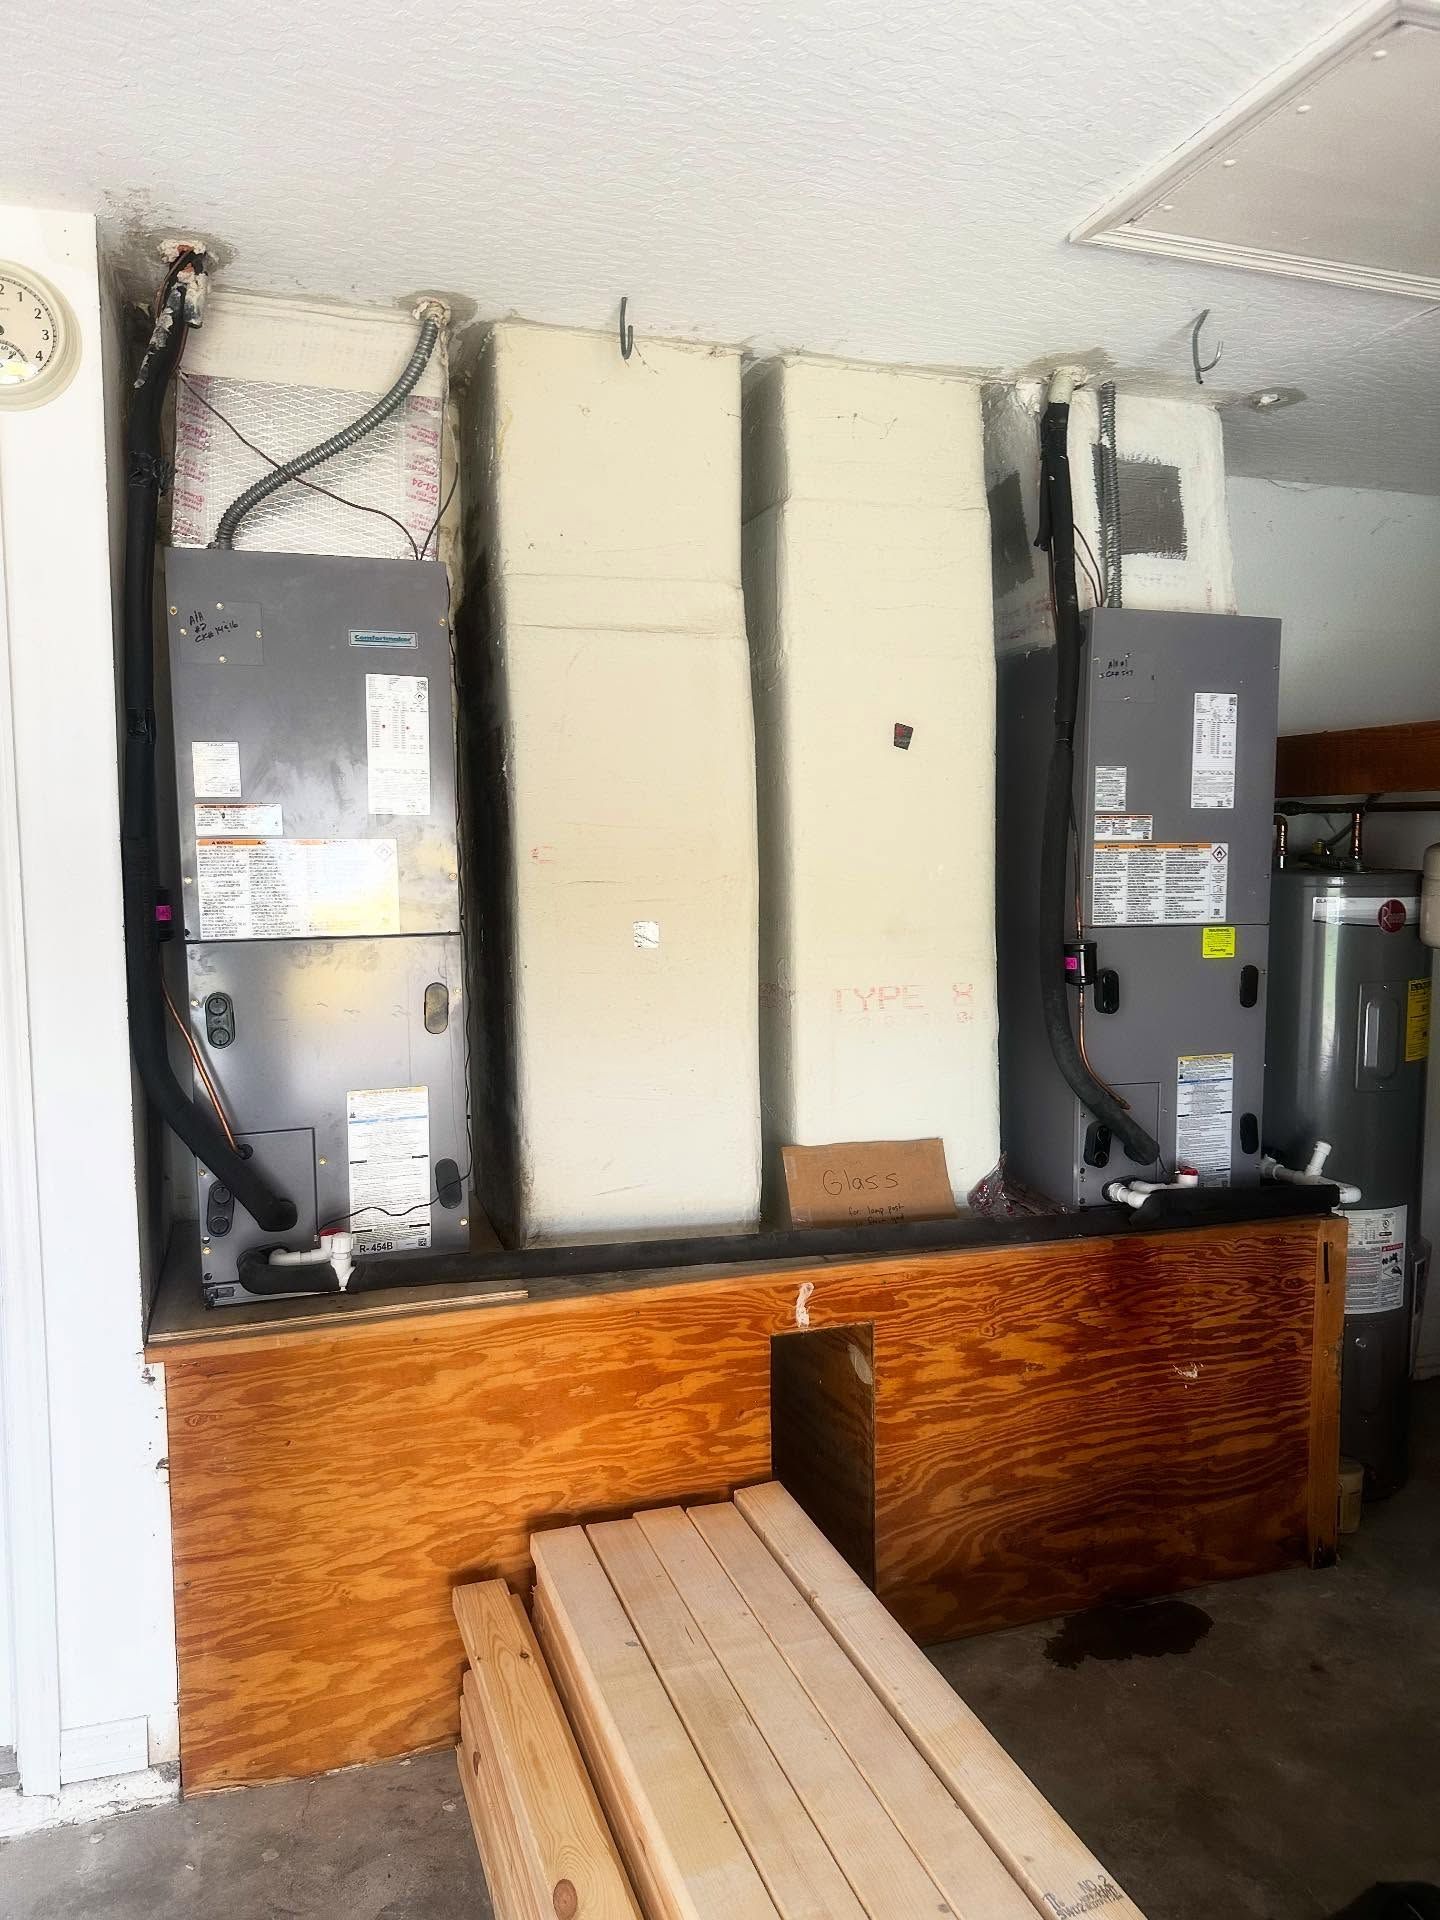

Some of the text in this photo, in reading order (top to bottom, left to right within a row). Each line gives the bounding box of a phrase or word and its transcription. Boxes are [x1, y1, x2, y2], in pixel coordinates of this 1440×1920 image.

[17, 291, 23, 302] 1
[34, 307, 42, 319] 2
[41, 329, 49, 340] 3
[35, 350, 43, 361] 4
[833, 984, 927, 1012] TYPE
[822, 1169, 899, 1195] Glass
